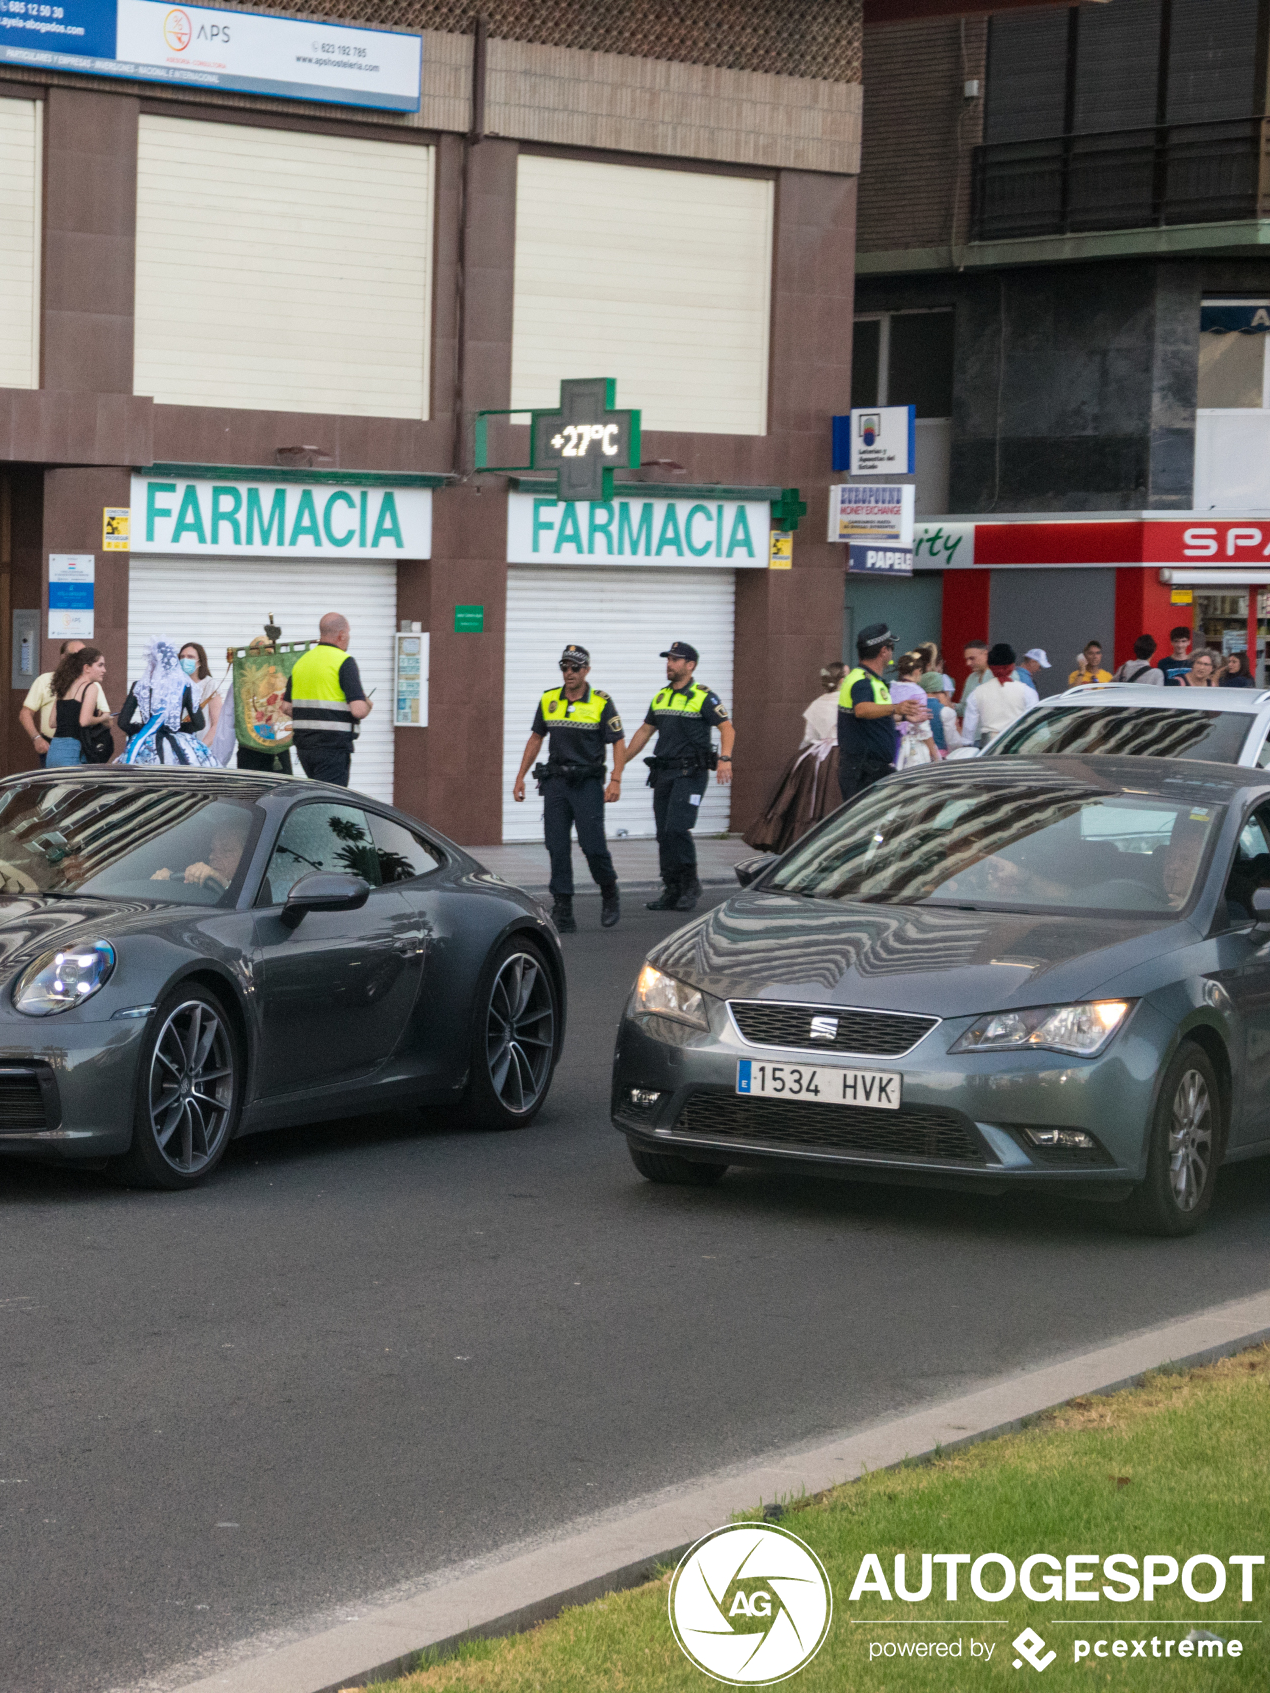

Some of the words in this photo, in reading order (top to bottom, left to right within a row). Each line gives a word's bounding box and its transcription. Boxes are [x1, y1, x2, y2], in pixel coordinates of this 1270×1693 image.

[8, 1, 26, 14] 685
[27, 4, 38, 16] 12
[39, 5, 51, 17] 50
[52, 6, 64, 19] 30
[196, 24, 230, 43] APS
[6, 49, 52, 64] PARTICULARES
[321, 42, 335, 54] 623
[352, 46, 367, 58] 785
[295, 54, 380, 73] www.apshosteleria.com
[145, 481, 405, 549] FARMACIA
[840, 506, 864, 515] MONEY
[865, 506, 901, 515] EXCHANGE
[532, 497, 756, 558] FARMACIA
[913, 527, 963, 564] ity
[1183, 527, 1270, 557] SP
[741, 1080, 748, 1088] E
[758, 1065, 821, 1097] 1534
[842, 1073, 894, 1104] HVK
